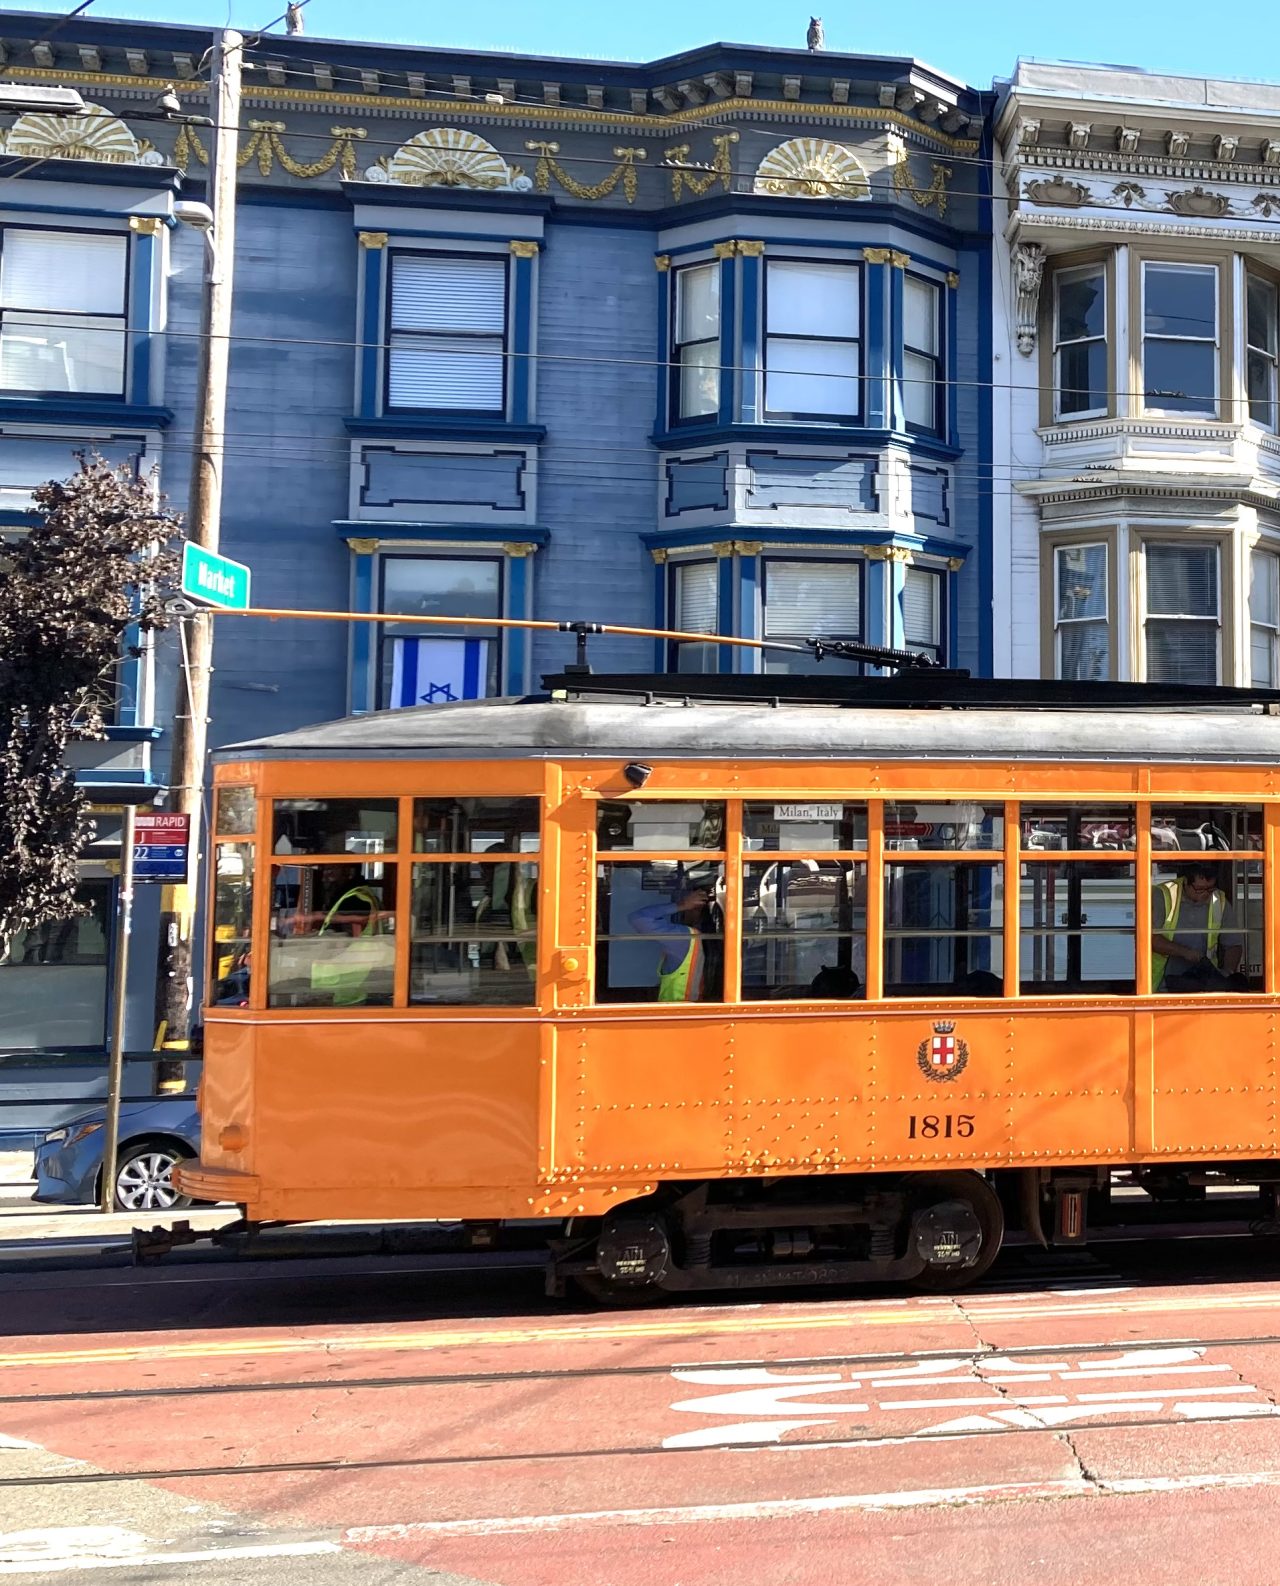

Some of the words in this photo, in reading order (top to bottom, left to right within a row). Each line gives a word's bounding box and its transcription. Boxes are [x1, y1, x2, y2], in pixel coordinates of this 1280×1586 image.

[197, 561, 236, 599] Market
[779, 805, 813, 819] Milan,
[816, 805, 839, 819] Italy
[155, 816, 186, 828] RAPID
[139, 831, 146, 844] J
[133, 846, 150, 860] 22
[1240, 963, 1262, 973] EXIT
[909, 1115, 975, 1139] 1815
